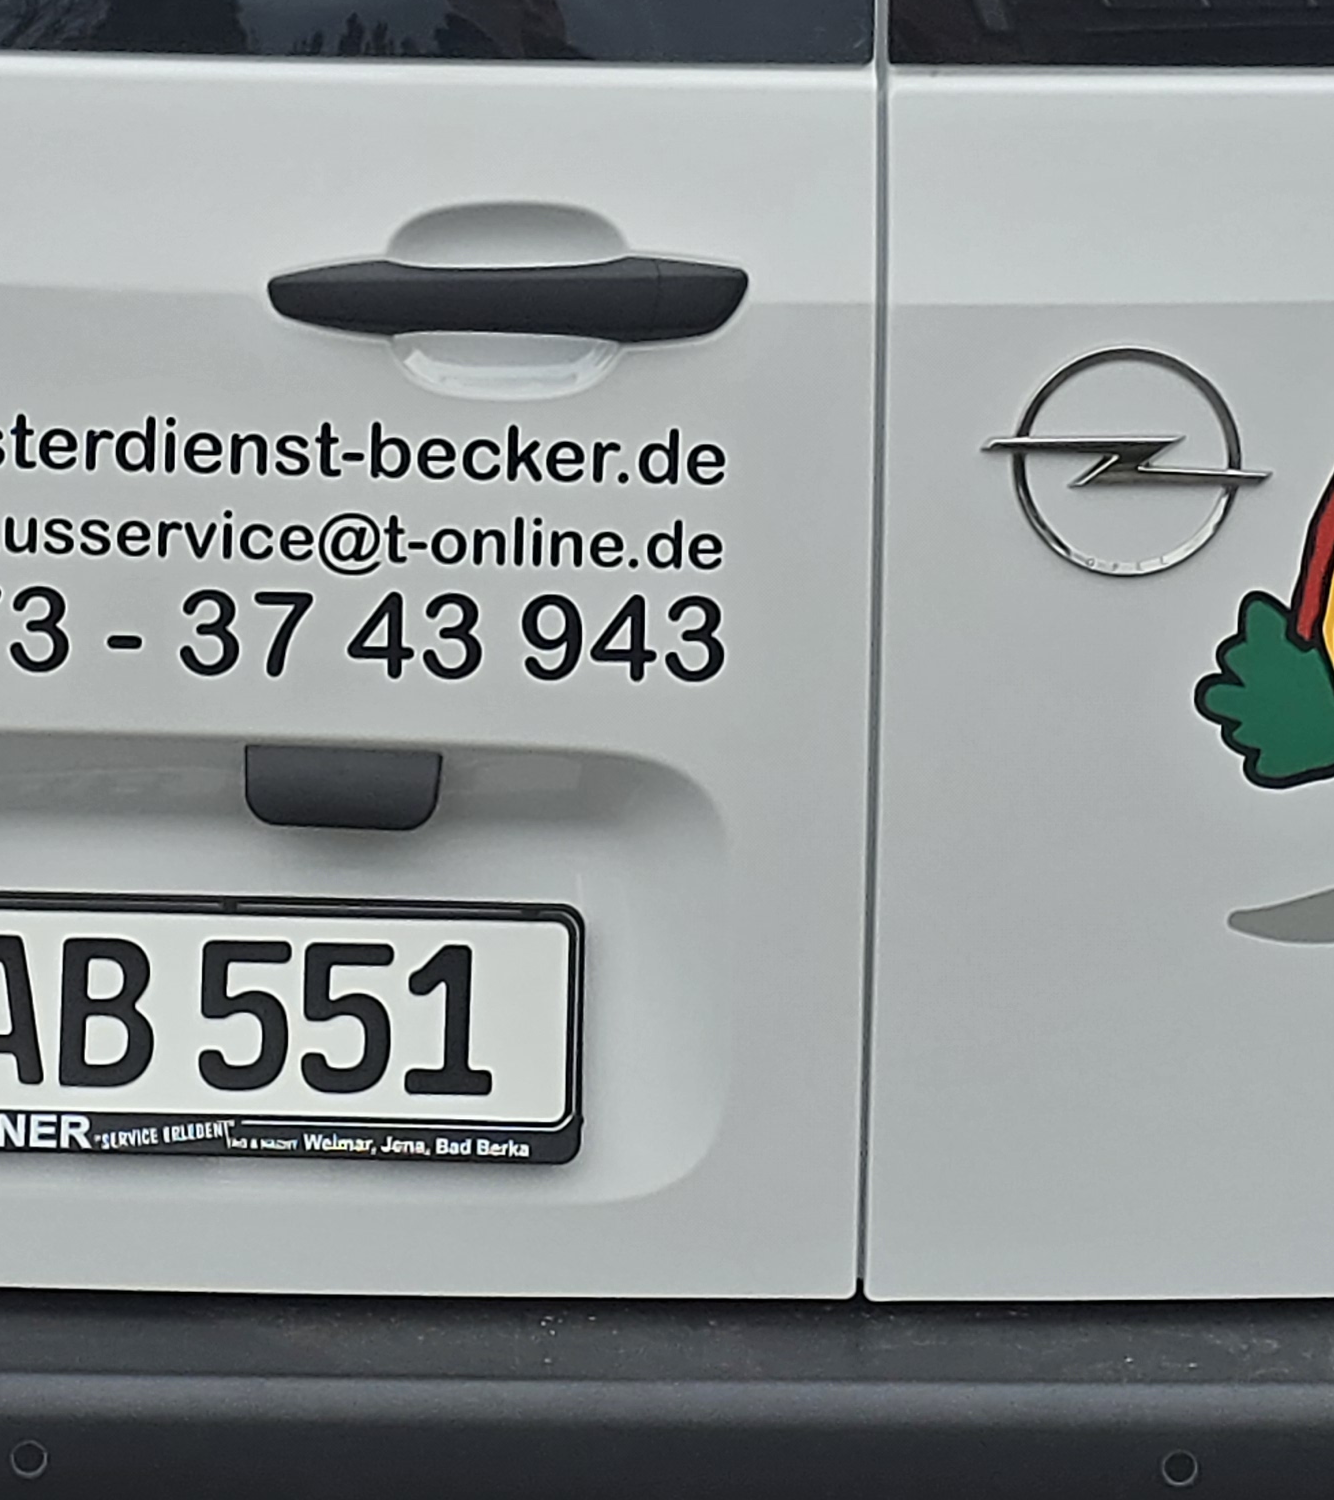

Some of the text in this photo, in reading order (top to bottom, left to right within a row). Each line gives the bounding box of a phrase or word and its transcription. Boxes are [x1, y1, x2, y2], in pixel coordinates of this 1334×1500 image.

[179, 589, 314, 678] 37
[347, 591, 482, 680] 43
[521, 594, 725, 683] 943
[198, 940, 493, 1097] 551
[435, 1137, 472, 1156] Bad
[476, 1139, 530, 1158] Berka
